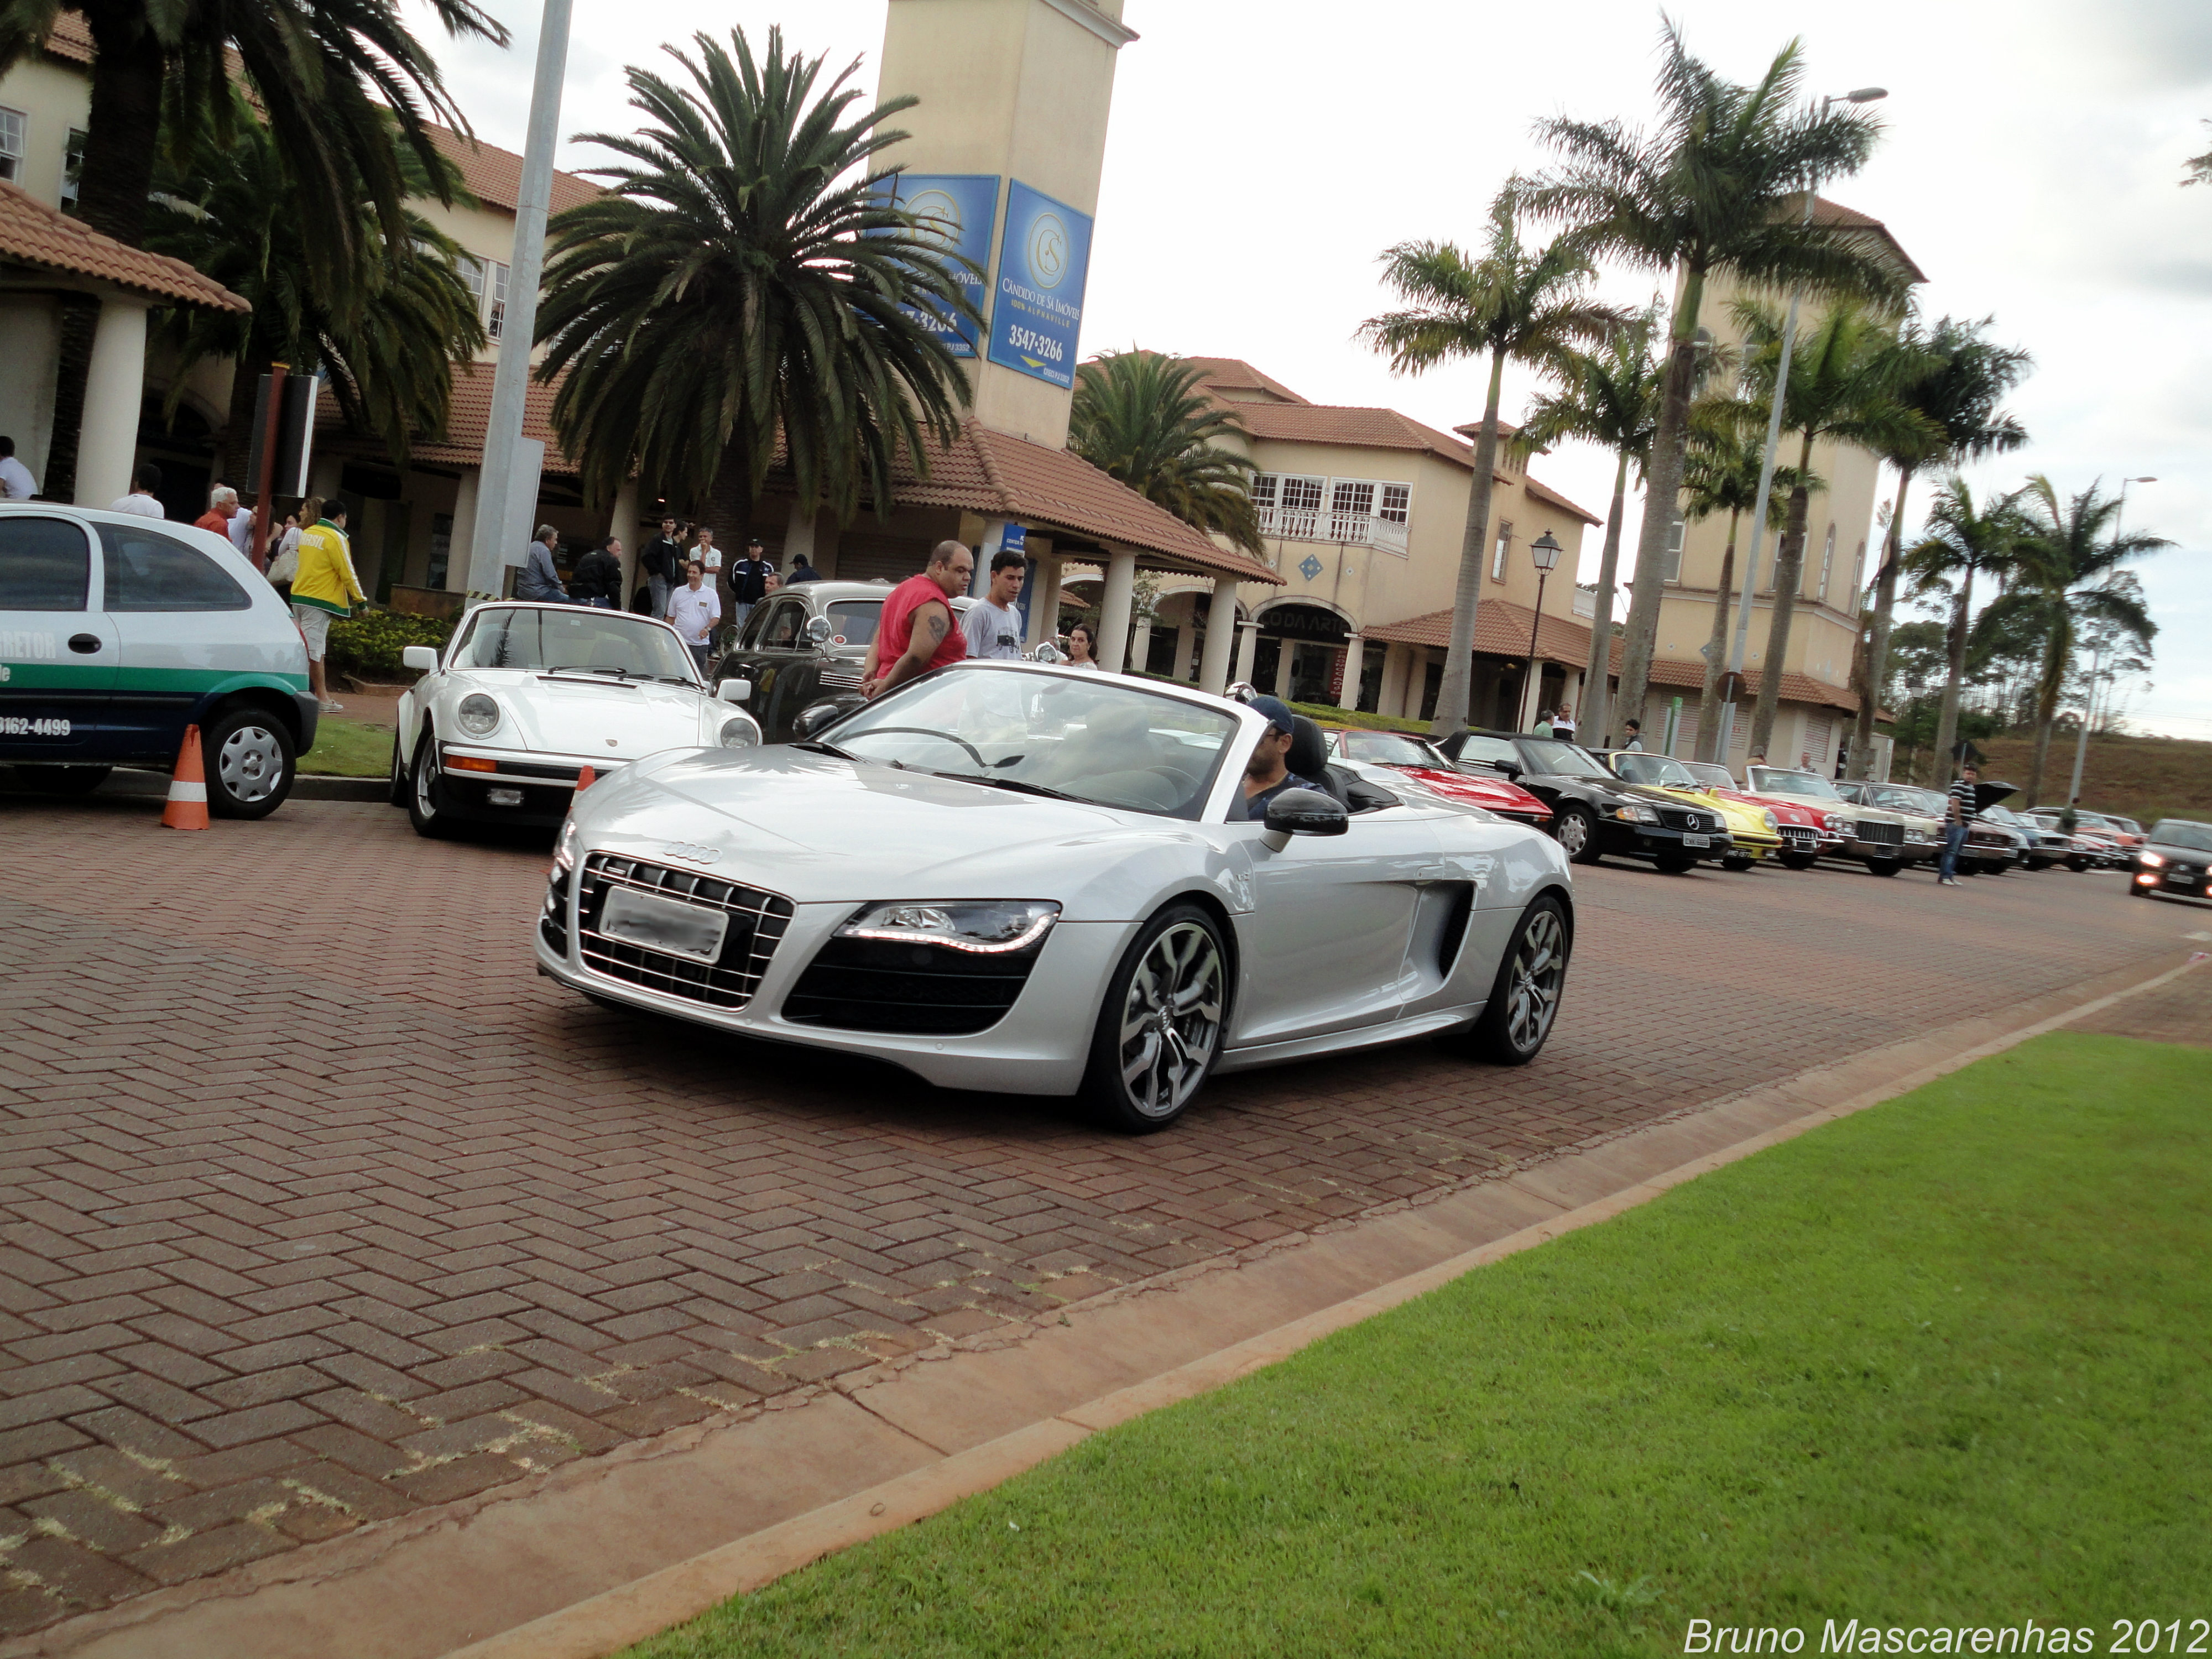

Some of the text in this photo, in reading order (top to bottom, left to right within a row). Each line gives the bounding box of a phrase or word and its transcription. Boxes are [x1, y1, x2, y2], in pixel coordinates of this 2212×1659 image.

[1002, 278, 1080, 320] CÂNDIDO DE SÁ IMÓVEIS
[1027, 305, 1070, 328] ALPHAVILLE
[299, 533, 325, 550] RASIL
